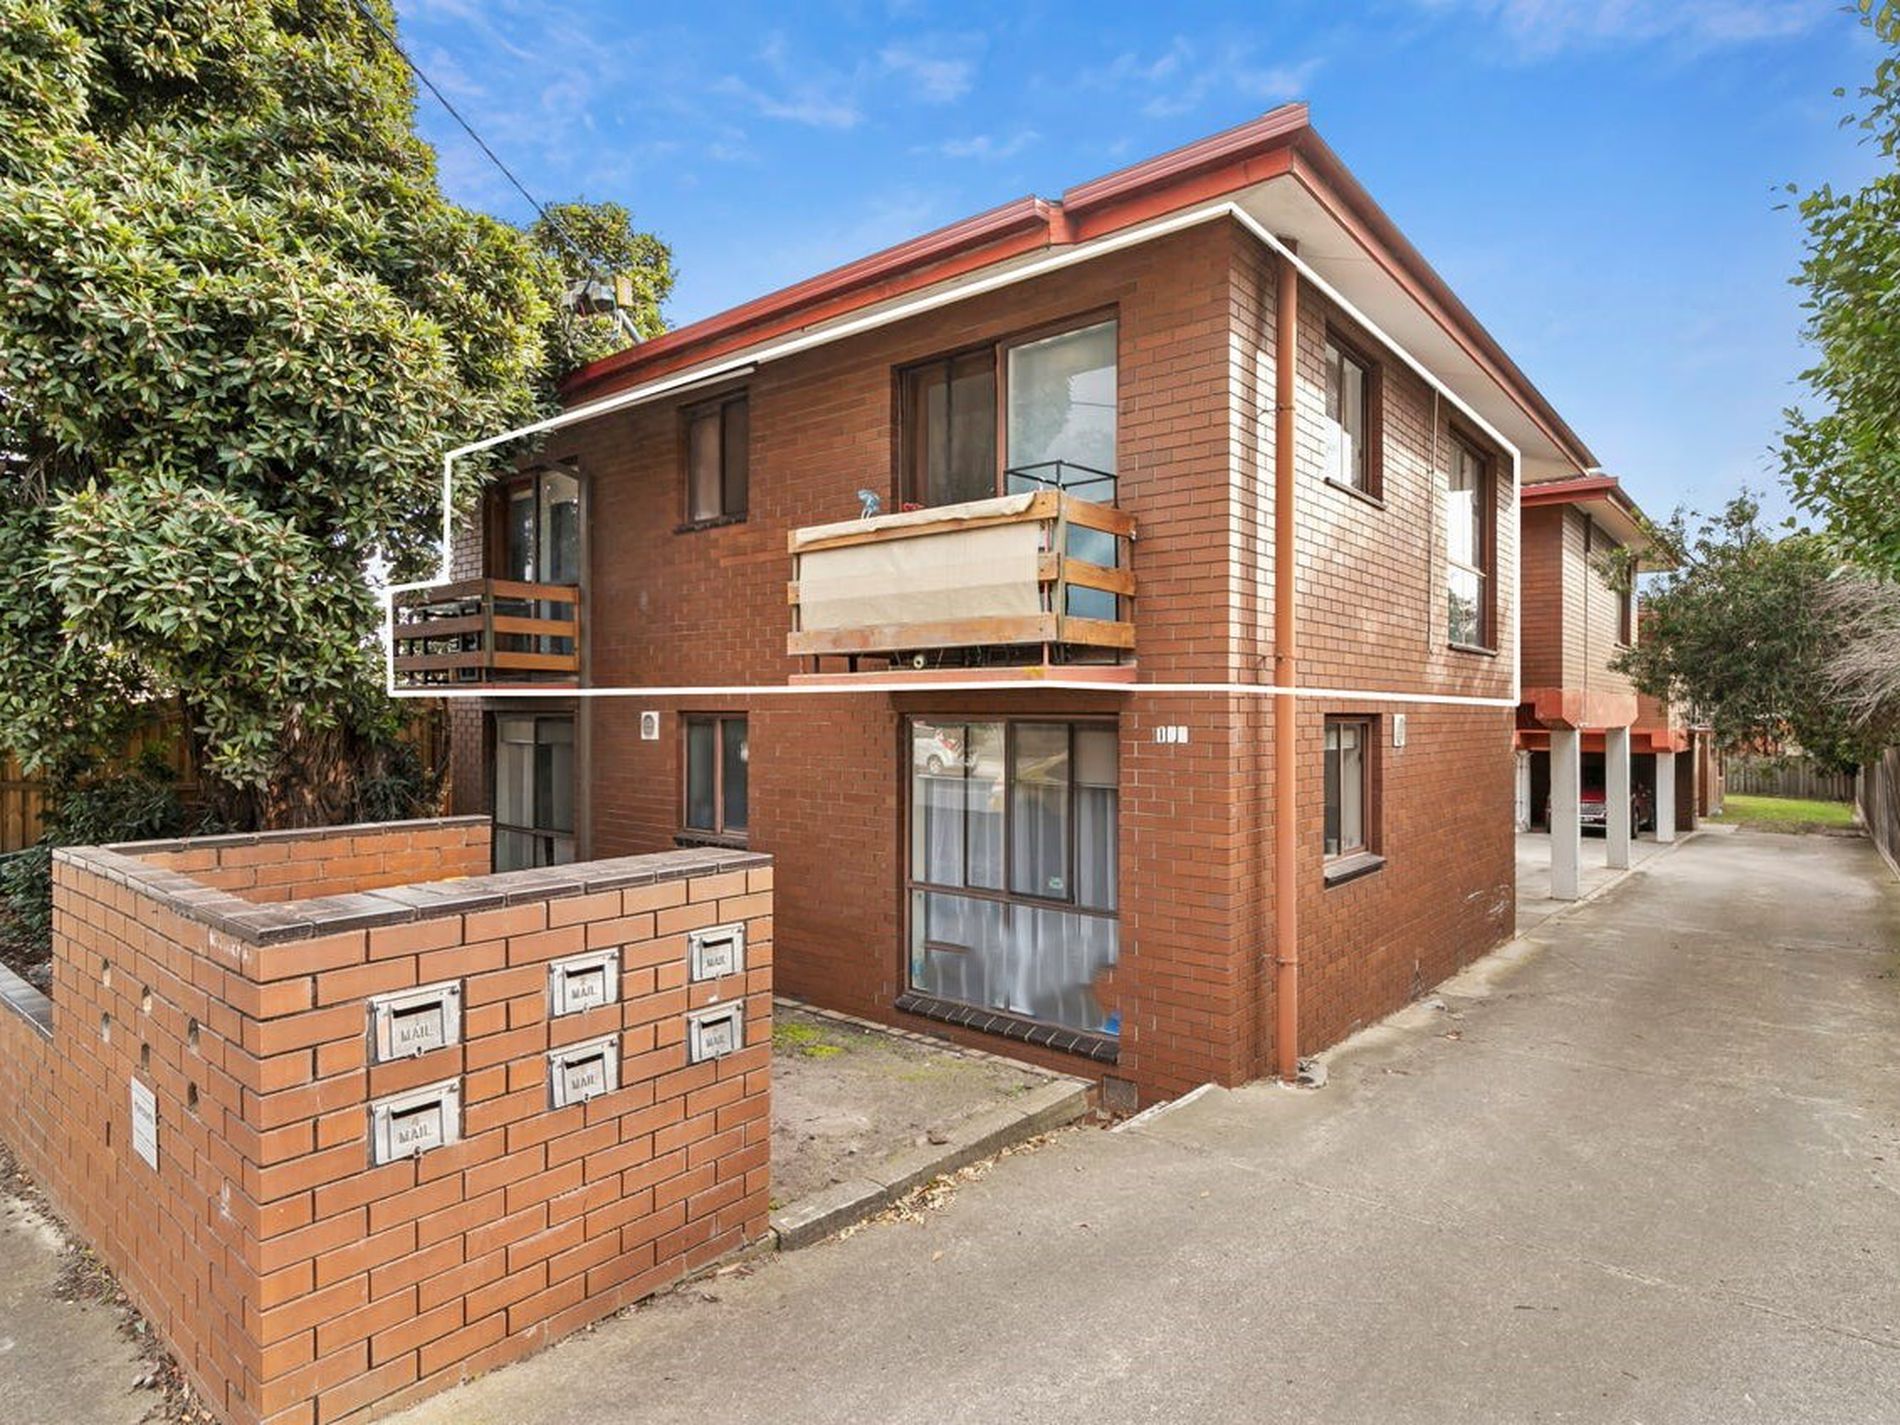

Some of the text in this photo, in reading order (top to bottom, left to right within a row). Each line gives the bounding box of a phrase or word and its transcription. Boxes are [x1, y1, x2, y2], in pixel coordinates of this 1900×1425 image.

[571, 985, 597, 999] MAIL
[401, 1024, 432, 1042] MAIL
[571, 1075, 596, 1089] MAIL
[399, 1124, 432, 1143] MAIL
